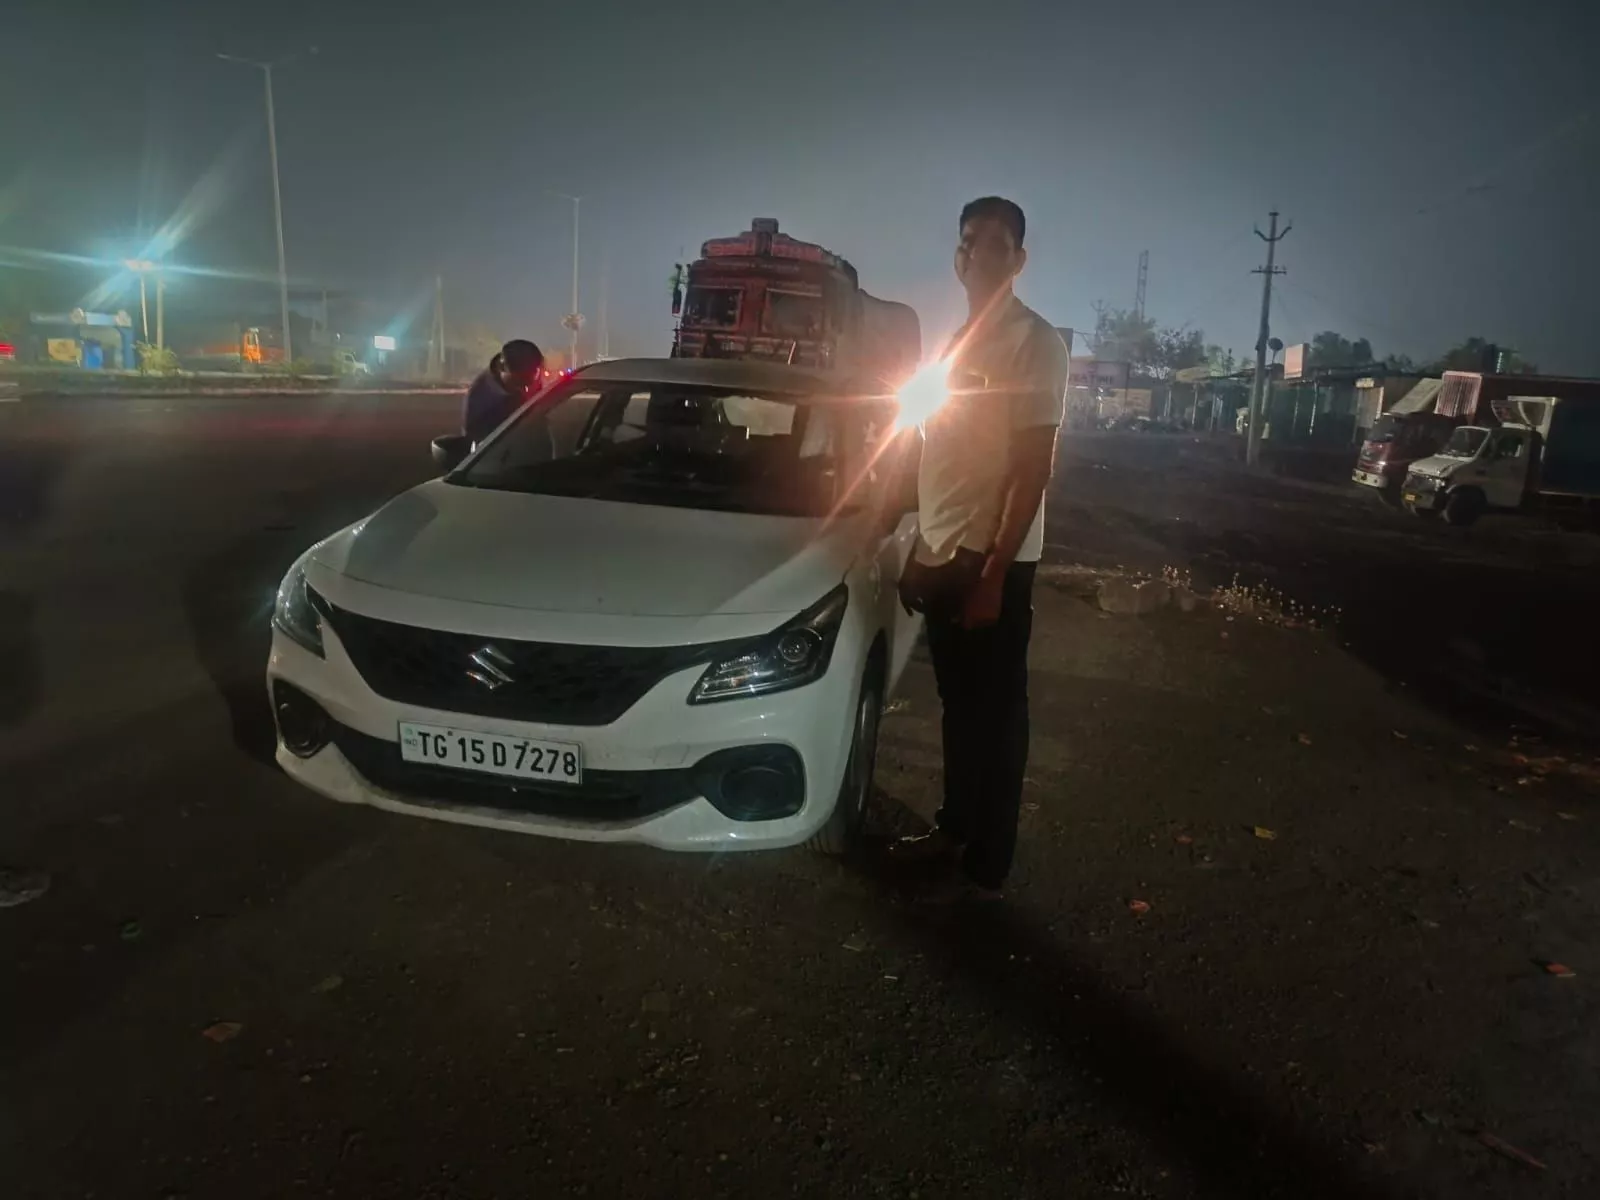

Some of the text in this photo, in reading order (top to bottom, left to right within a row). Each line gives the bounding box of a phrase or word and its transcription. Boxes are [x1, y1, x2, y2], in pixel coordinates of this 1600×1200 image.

[418, 731, 577, 776] TG 15 D 7278
